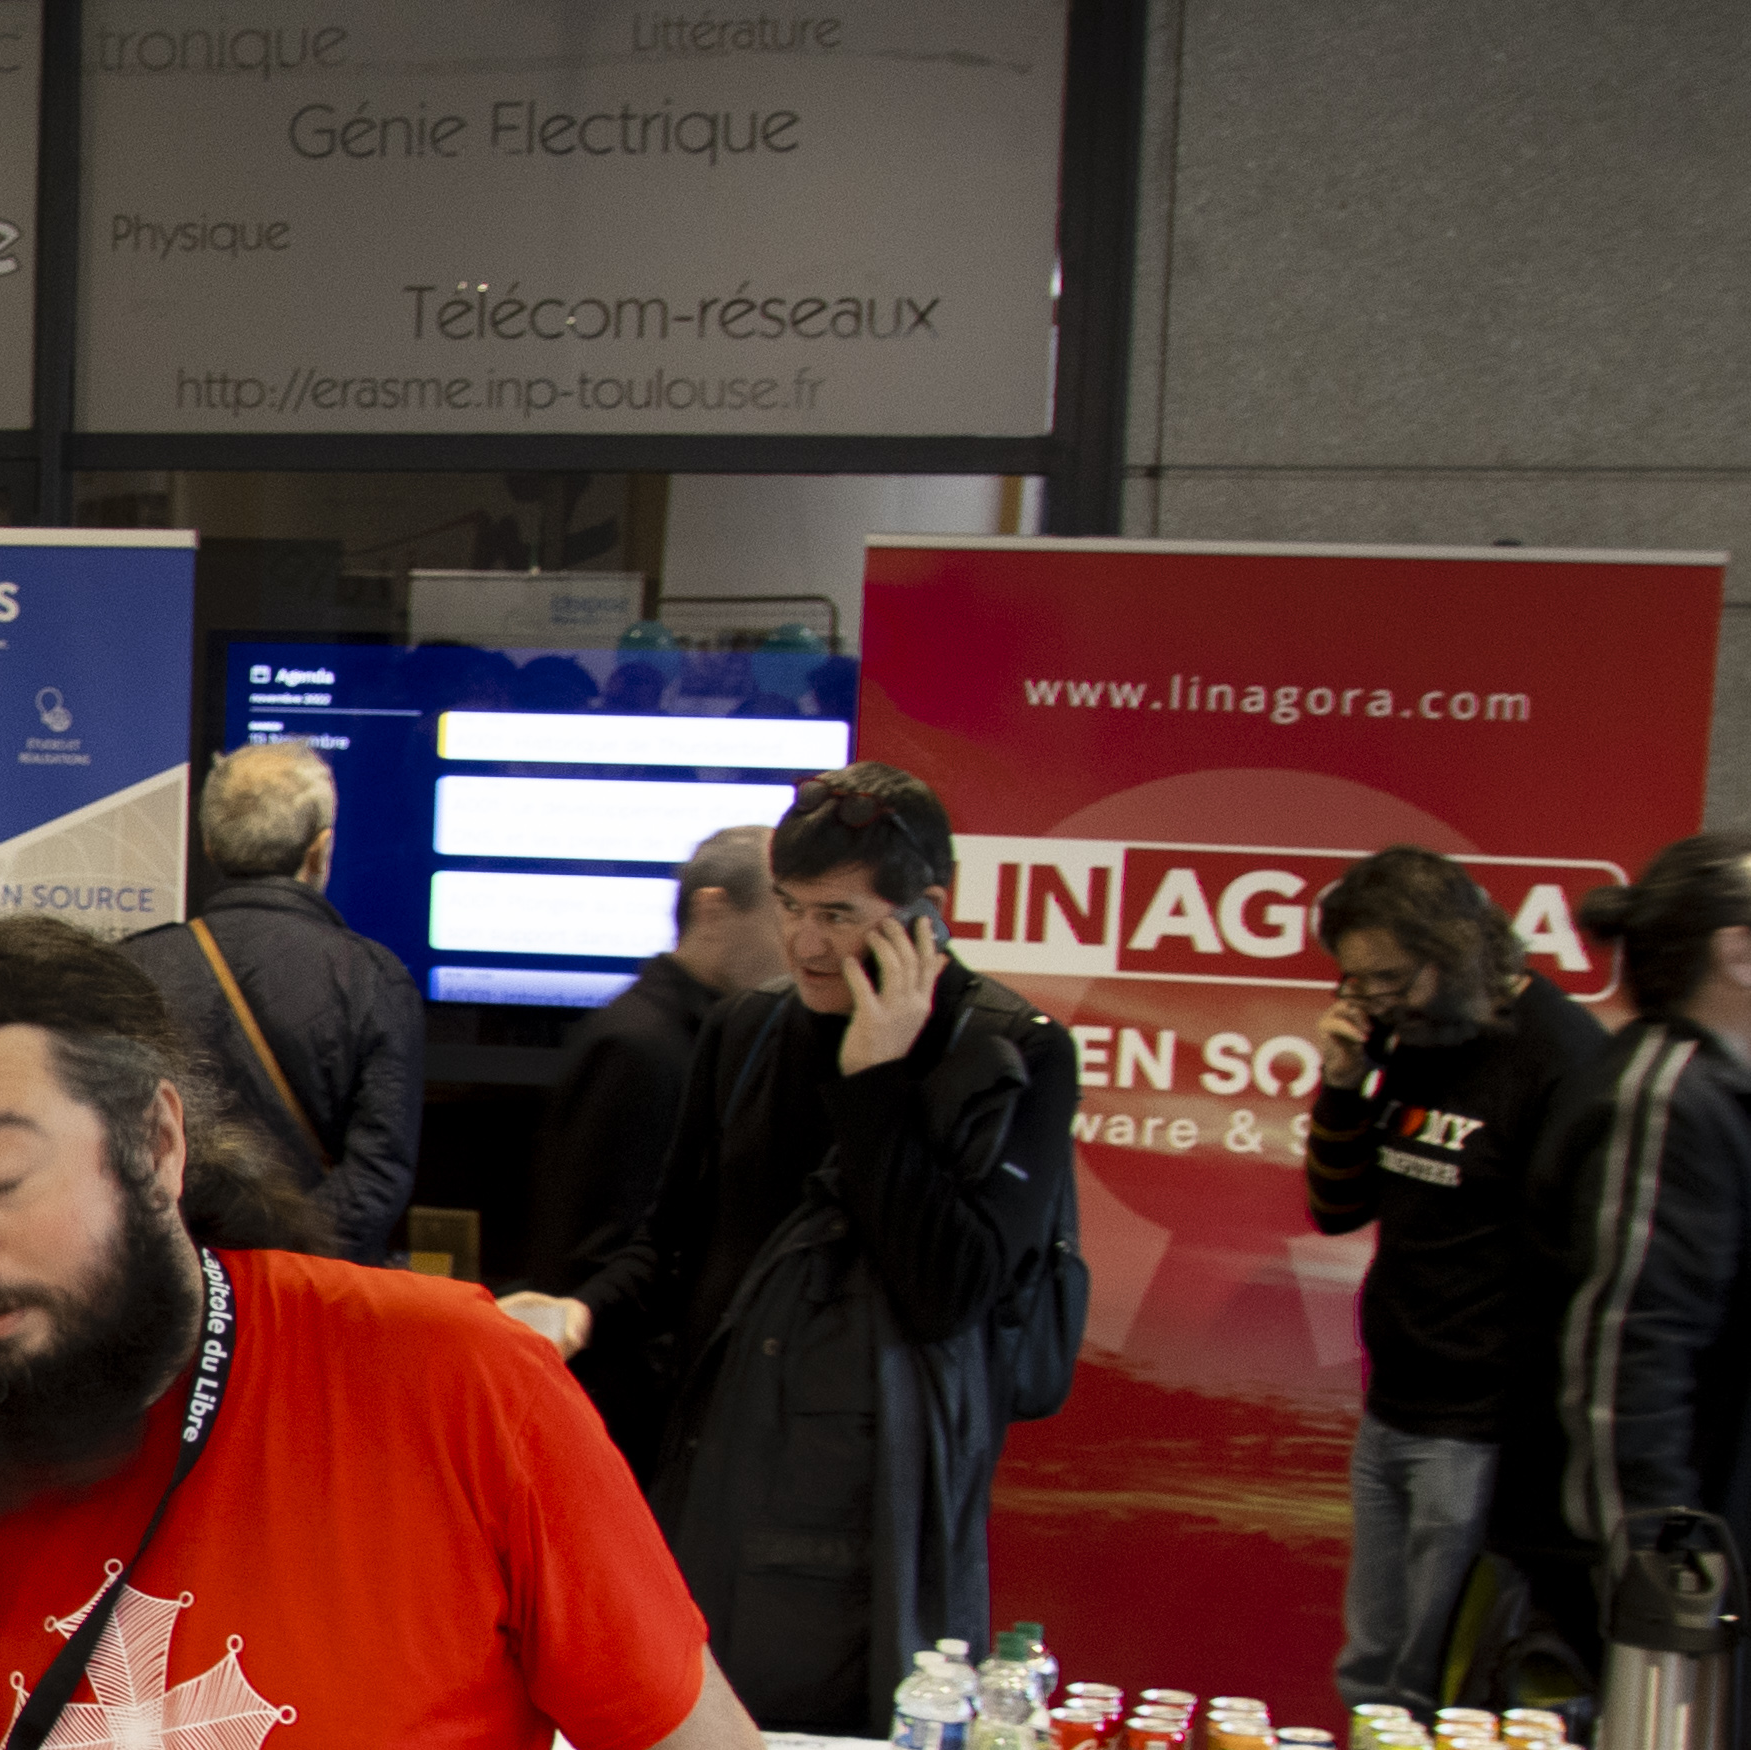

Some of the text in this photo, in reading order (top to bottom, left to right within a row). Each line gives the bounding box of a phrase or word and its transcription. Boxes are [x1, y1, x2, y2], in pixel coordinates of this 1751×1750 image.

[288, 97, 466, 160] Génie
[111, 213, 291, 259] Physique
[404, 282, 942, 342] Télécom-réseaux
[175, 366, 827, 416] http://erasme.inp-toulouse.fr
[1025, 674, 1532, 725] www.linagora.com
[32, 883, 156, 914] SOURCE
[946, 860, 1592, 973] LINAGA
[1071, 1025, 1177, 1091] EN
[1070, 1111, 1199, 1154] ware
[201, 1339, 228, 1373] du
[183, 1376, 219, 1443] Libre
